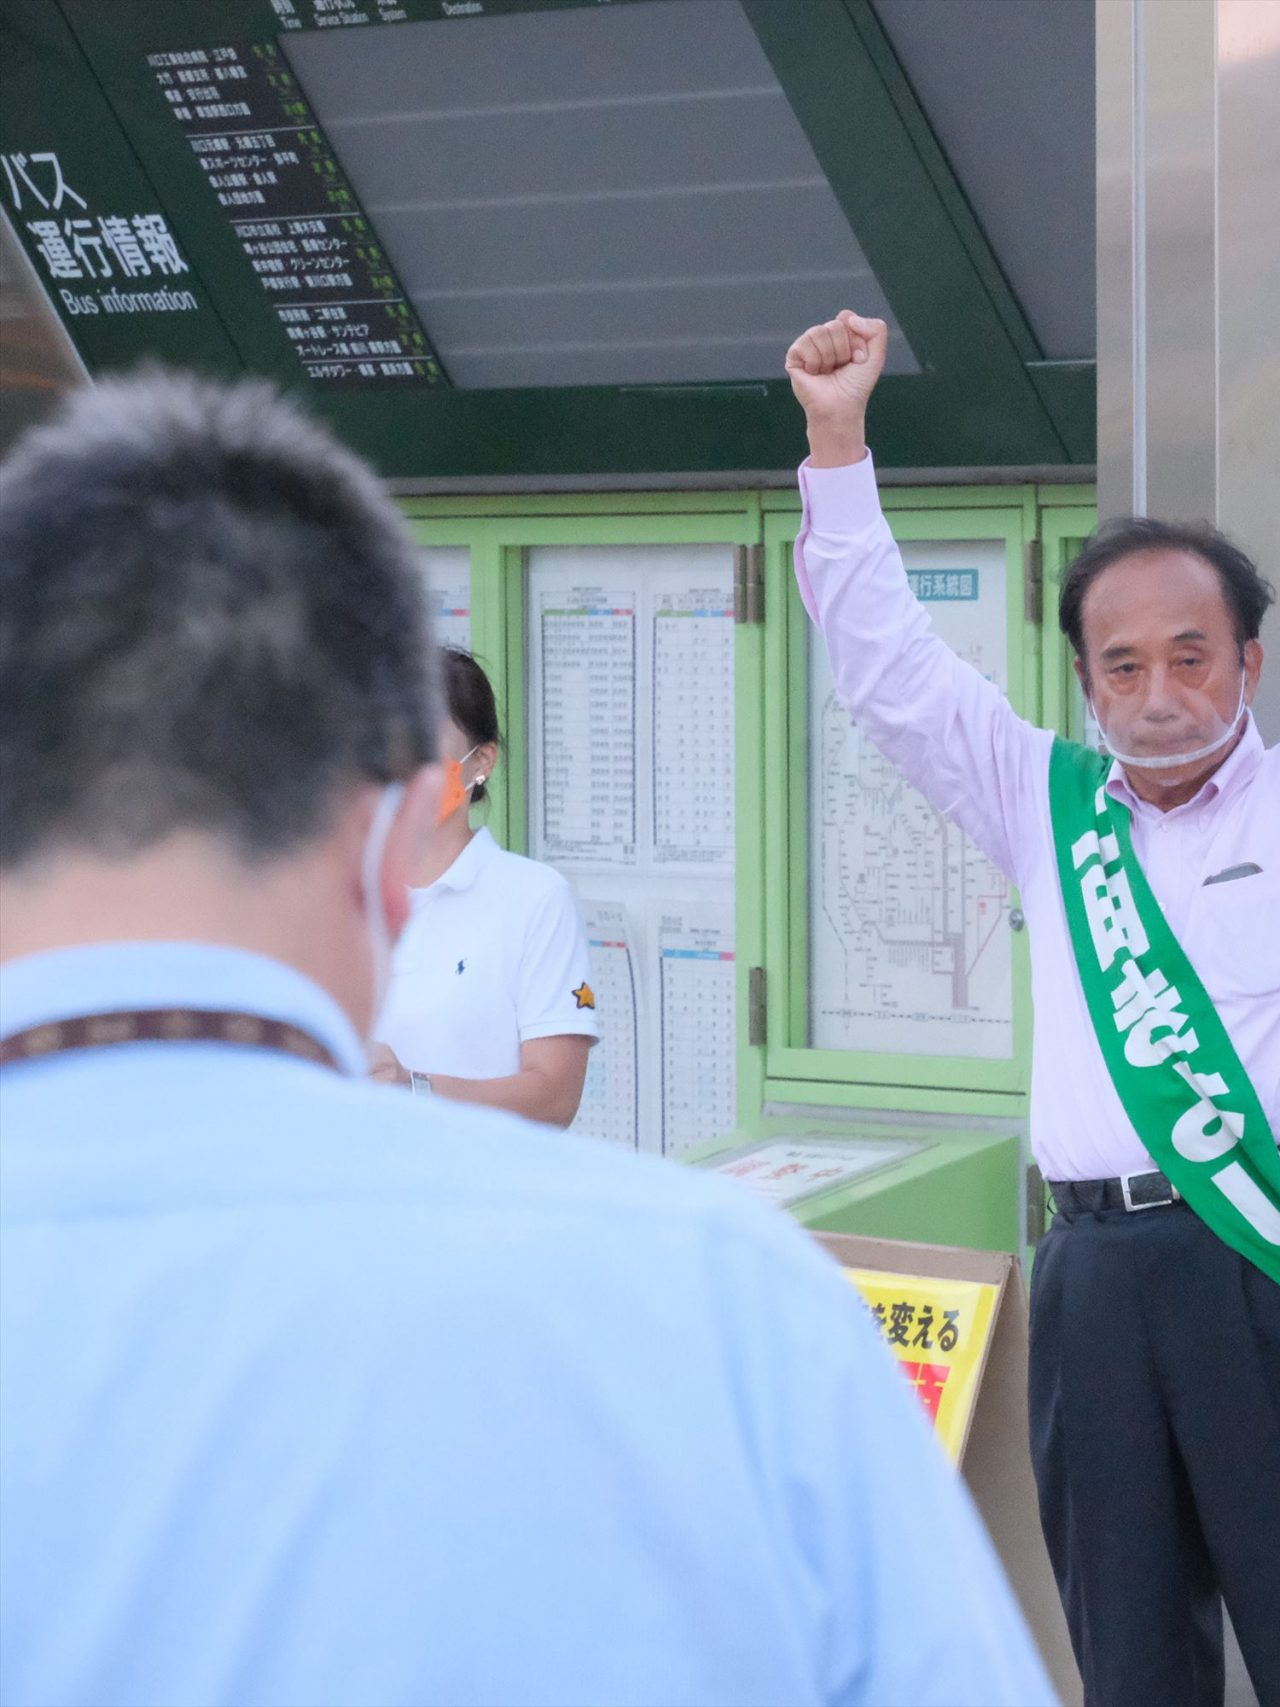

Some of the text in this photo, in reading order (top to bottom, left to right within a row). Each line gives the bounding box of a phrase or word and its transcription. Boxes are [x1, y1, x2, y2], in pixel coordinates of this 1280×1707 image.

[1, 152, 88, 211] バス
[26, 214, 190, 279] 運行情報
[59, 284, 198, 315] Bus information
